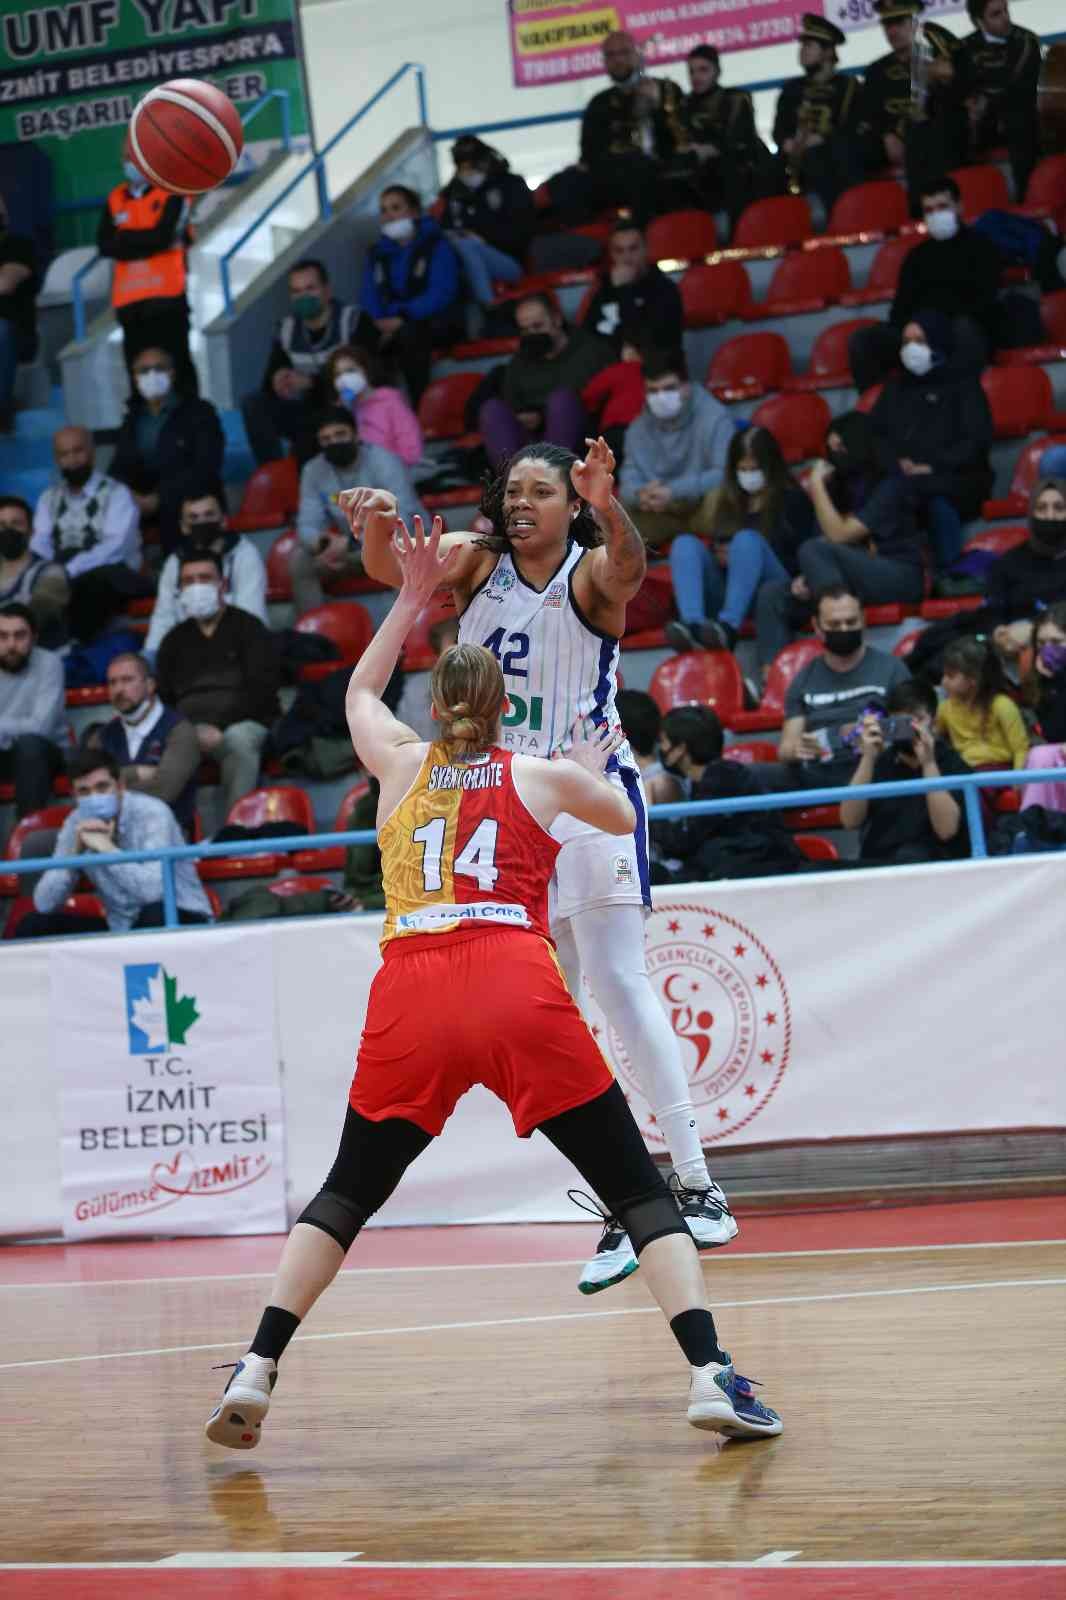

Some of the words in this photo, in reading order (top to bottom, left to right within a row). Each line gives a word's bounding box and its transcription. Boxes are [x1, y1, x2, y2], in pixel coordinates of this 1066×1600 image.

[5, 2, 119, 59] UMF
[0, 73, 63, 101] ZMİT
[68, 33, 284, 90] BELEDİYESPOR'A
[17, 96, 132, 140] BAŞARIL
[483, 627, 530, 678] 42
[500, 692, 543, 731] DI
[504, 732, 540, 750] RTA
[412, 816, 499, 892] 14
[144, 1057, 192, 1076] T.C.
[127, 1081, 216, 1113] İZMİT
[80, 1113, 267, 1151] BELEDİYESİ
